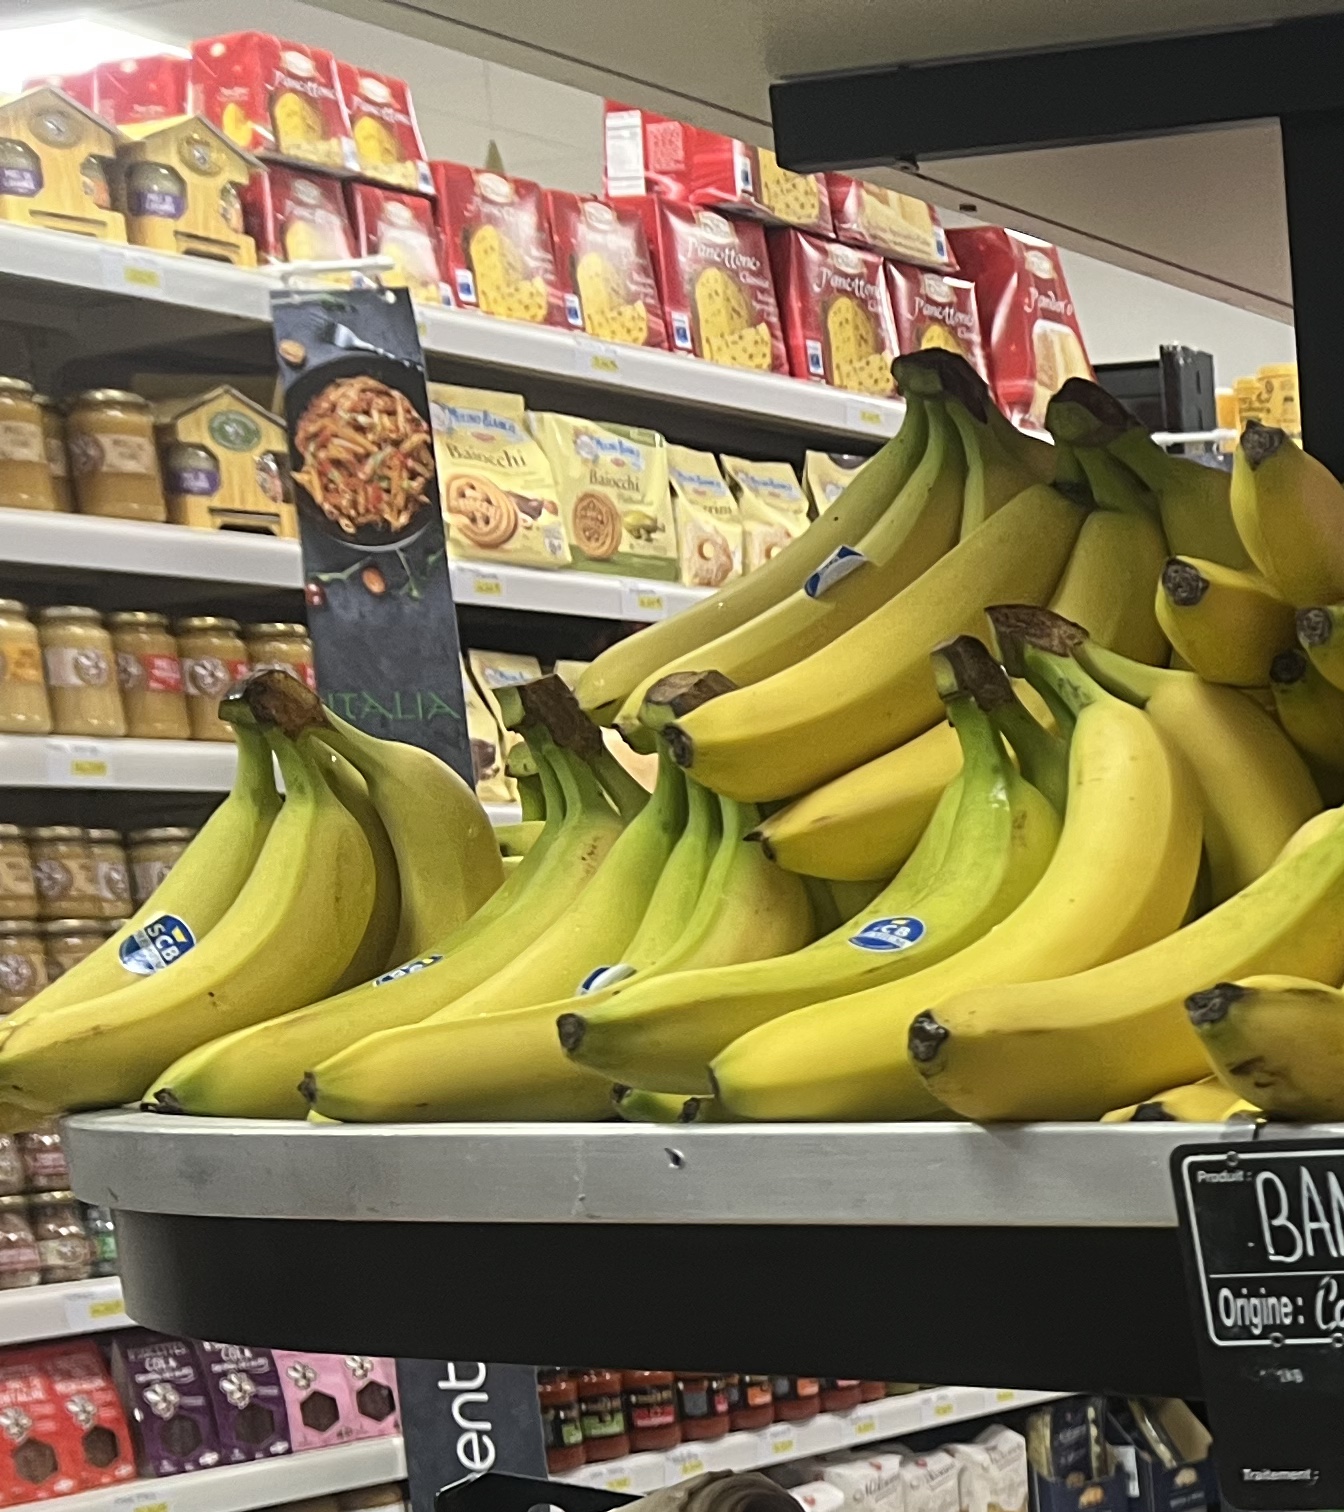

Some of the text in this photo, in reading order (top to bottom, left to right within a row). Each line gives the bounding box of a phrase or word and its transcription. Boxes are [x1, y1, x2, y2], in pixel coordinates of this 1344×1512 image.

[446, 442, 528, 468] Baiocchi
[589, 469, 641, 494] Baiocchi
[327, 691, 462, 721] ITALIA
[147, 923, 180, 961] SCB
